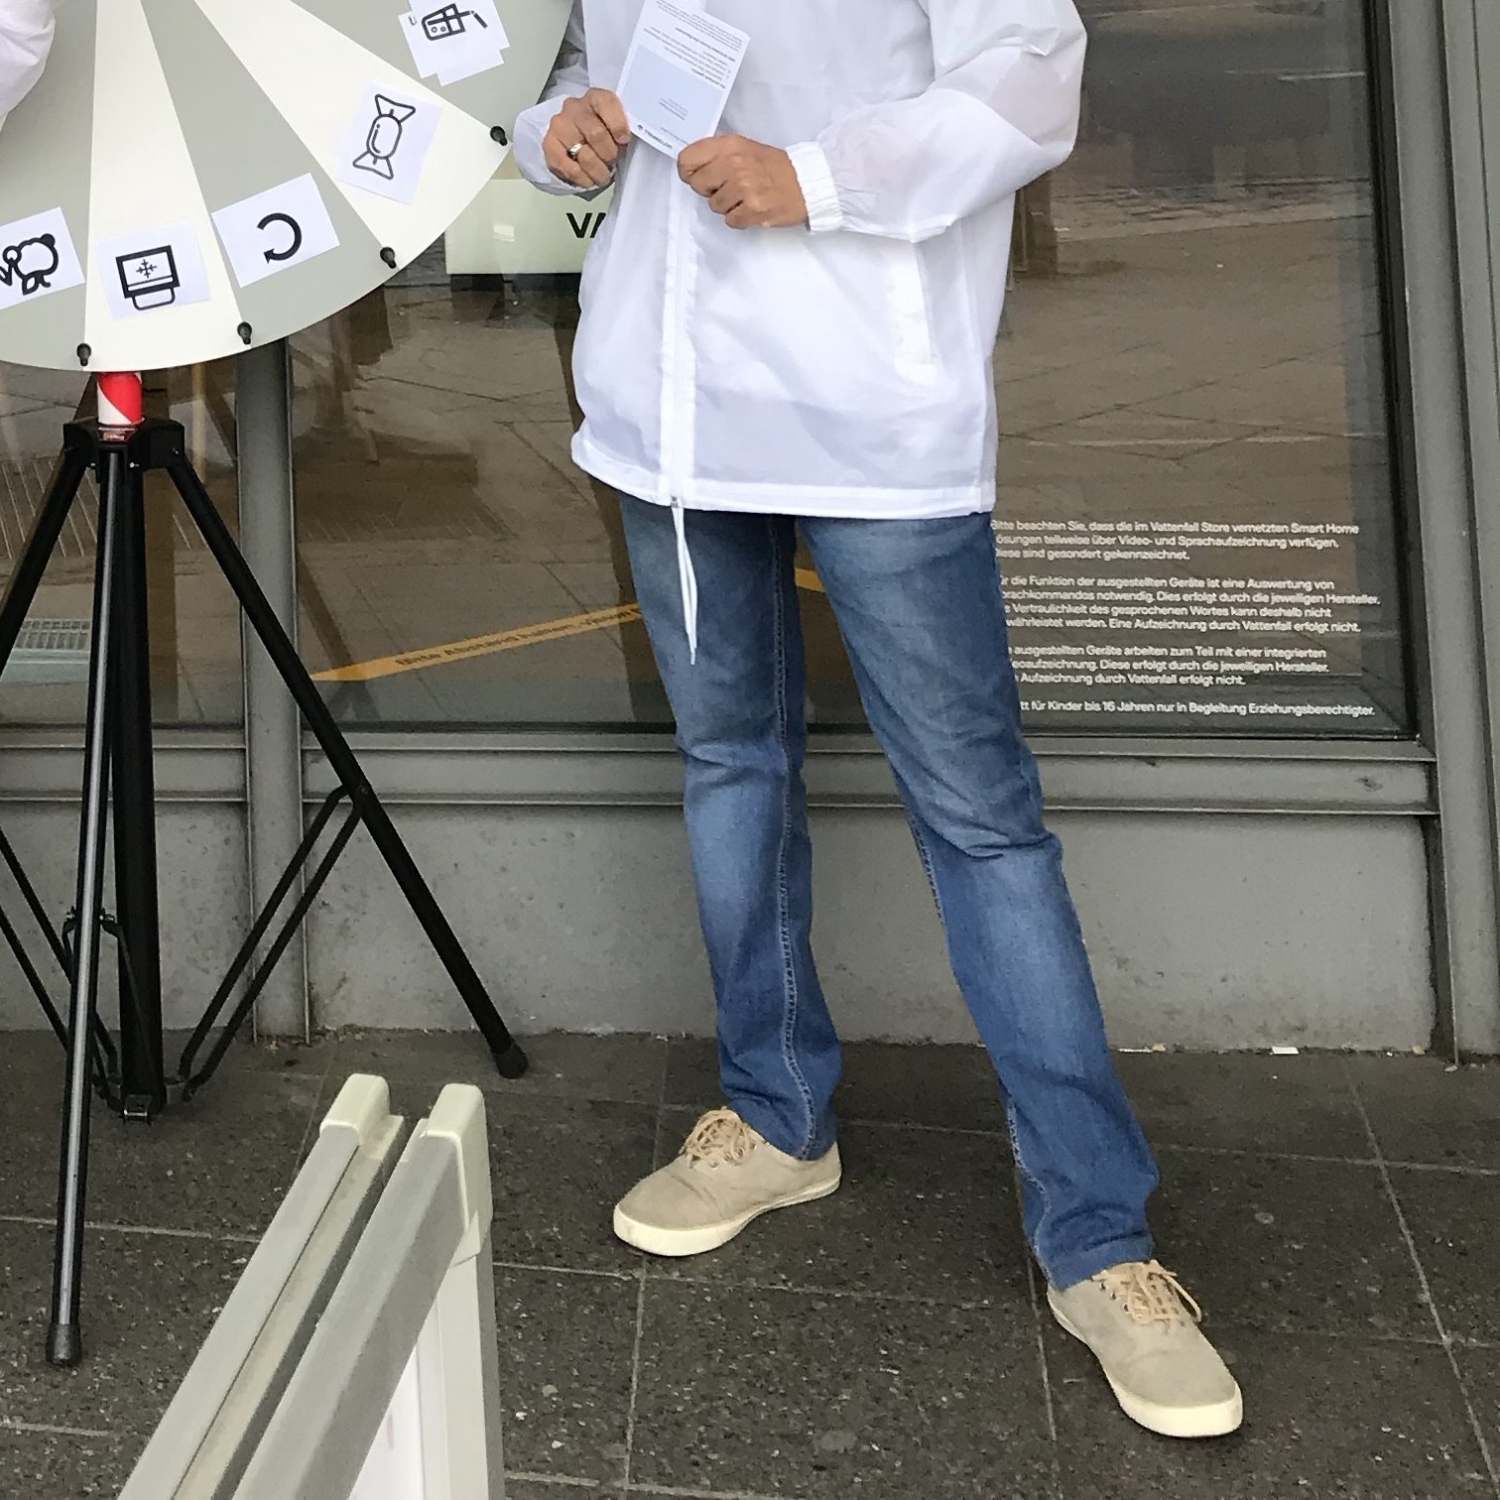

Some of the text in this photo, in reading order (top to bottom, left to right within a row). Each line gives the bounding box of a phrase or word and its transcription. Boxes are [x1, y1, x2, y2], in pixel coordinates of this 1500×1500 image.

[1016, 520, 1066, 531] beachten
[1115, 521, 1133, 531] die
[1134, 521, 1149, 531] im
[1150, 522, 1199, 532] Vattenfall
[1201, 522, 1230, 532] Store
[1232, 523, 1289, 533] vernetzten
[1291, 523, 1325, 533] Smart
[1326, 524, 1359, 534] Home
[1154, 536, 1176, 546] und
[1177, 536, 1287, 548] Sprachaufzeichnung
[1023, 549, 1045, 559] sind
[1047, 549, 1101, 561] gesondert
[1010, 576, 1027, 586] die
[1029, 576, 1075, 586] Funktion
[1076, 576, 1095, 586] der
[1097, 577, 1167, 588] ausgestellten
[1206, 578, 1220, 588] ist
[1222, 578, 1245, 588] eine
[1247, 578, 1312, 590] Auswertung
[1156, 591, 1180, 601] Dies
[1182, 592, 1217, 603] erfolgt
[1219, 592, 1250, 602] durch
[1252, 592, 1270, 602] die
[1271, 593, 1324, 604] jeweiligen
[1011, 604, 1088, 614] Vertraulichkeit
[1089, 605, 1110, 615] des
[1111, 605, 1188, 617] gesprochenen
[1189, 606, 1229, 616] Wortes
[1231, 606, 1258, 616] kann
[1259, 606, 1303, 617] deshalb
[1304, 607, 1332, 617] nicht
[1109, 619, 1132, 629] Eine
[1134, 620, 1207, 631] Aufzeichnung
[1208, 620, 1241, 631] durch
[1242, 621, 1292, 631] Vattenfall
[1293, 621, 1329, 633] erfolgt
[1014, 645, 1085, 657] ausgestellten
[1124, 646, 1168, 656] arbeiten
[1169, 649, 1193, 657] zum
[1195, 647, 1214, 657] Teil
[1215, 647, 1233, 657] mit
[1235, 647, 1263, 657] einer
[1264, 647, 1327, 659] integrierten
[1100, 660, 1131, 670] Diese
[1132, 661, 1167, 672] erfolgt
[1168, 661, 1201, 671] durch
[1202, 661, 1219, 671] die
[1220, 662, 1274, 673] jeweiligen
[1020, 674, 1093, 686] Aufzeichnung
[1094, 675, 1126, 685] durch
[1127, 675, 1177, 685] Vattenfall
[1179, 676, 1214, 687] erfolgt
[1031, 701, 1046, 711] für
[1047, 702, 1082, 712] Kinder
[1084, 702, 1101, 712] bis
[1102, 702, 1116, 712] 16
[1117, 703, 1155, 713] Jahren
[1177, 703, 1187, 713] in
[1189, 703, 1246, 715] Begleitung
